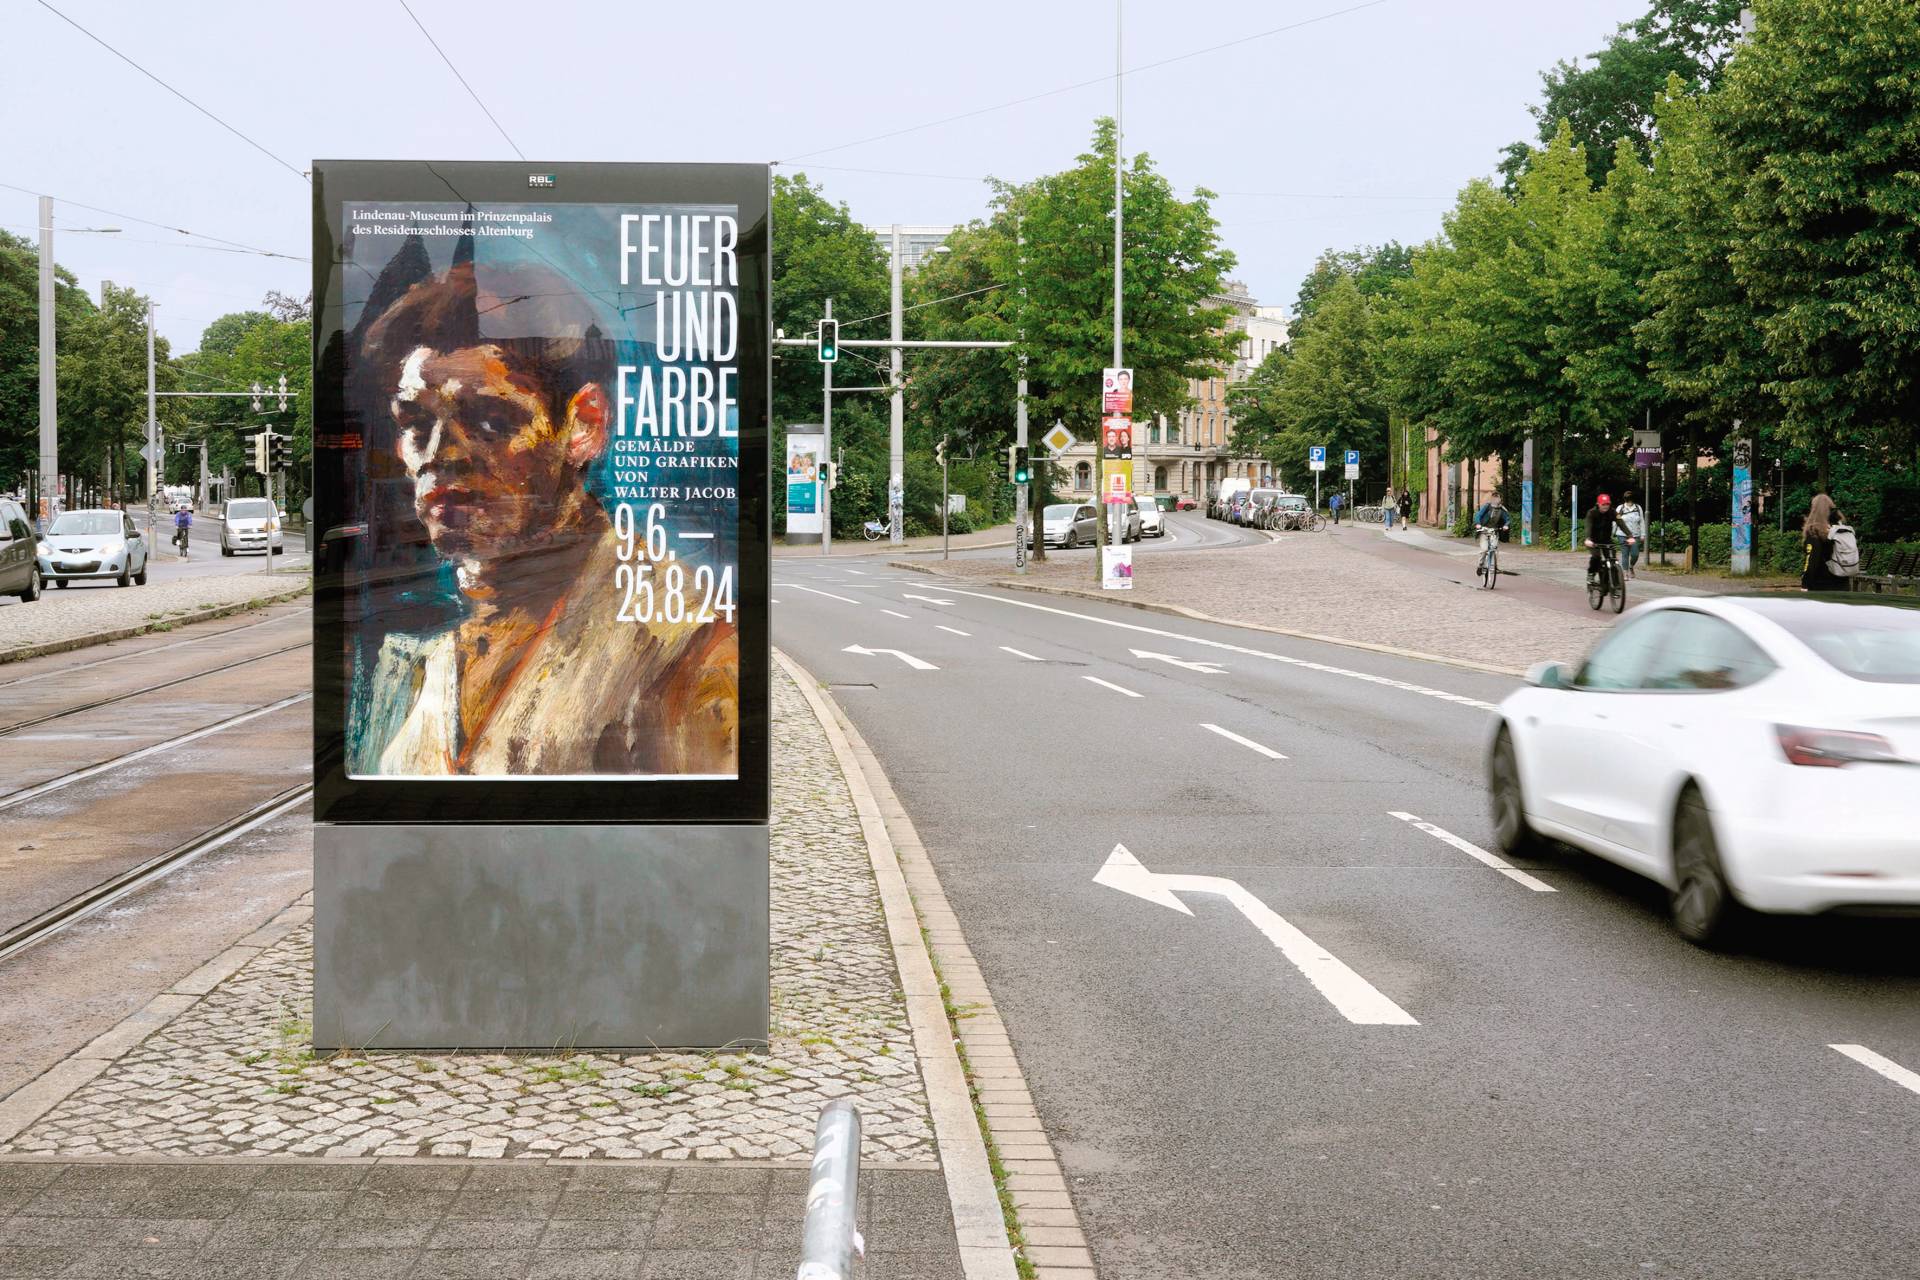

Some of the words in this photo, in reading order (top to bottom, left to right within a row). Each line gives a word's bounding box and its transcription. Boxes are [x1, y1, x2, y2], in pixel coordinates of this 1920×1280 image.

[529, 175, 553, 183] RBL
[352, 209, 459, 221] Lindenau-Museum
[460, 210, 475, 221] im
[477, 211, 552, 225] Prinzenpalais
[352, 224, 372, 235] des
[374, 224, 476, 236] Residenzschlosses
[478, 226, 534, 240] Altenburg
[620, 213, 739, 287] FEUER
[656, 290, 738, 362] UND
[616, 365, 739, 437] FARBE
[614, 438, 695, 452] GEMÄLDE
[614, 456, 650, 468] UND
[655, 456, 739, 468] GRAFIKEN
[1348, 453, 1355, 463] P
[614, 471, 648, 482] VON
[614, 486, 680, 499] WALTER
[685, 487, 736, 500] JACOB
[615, 565, 736, 624] 25.8.24
